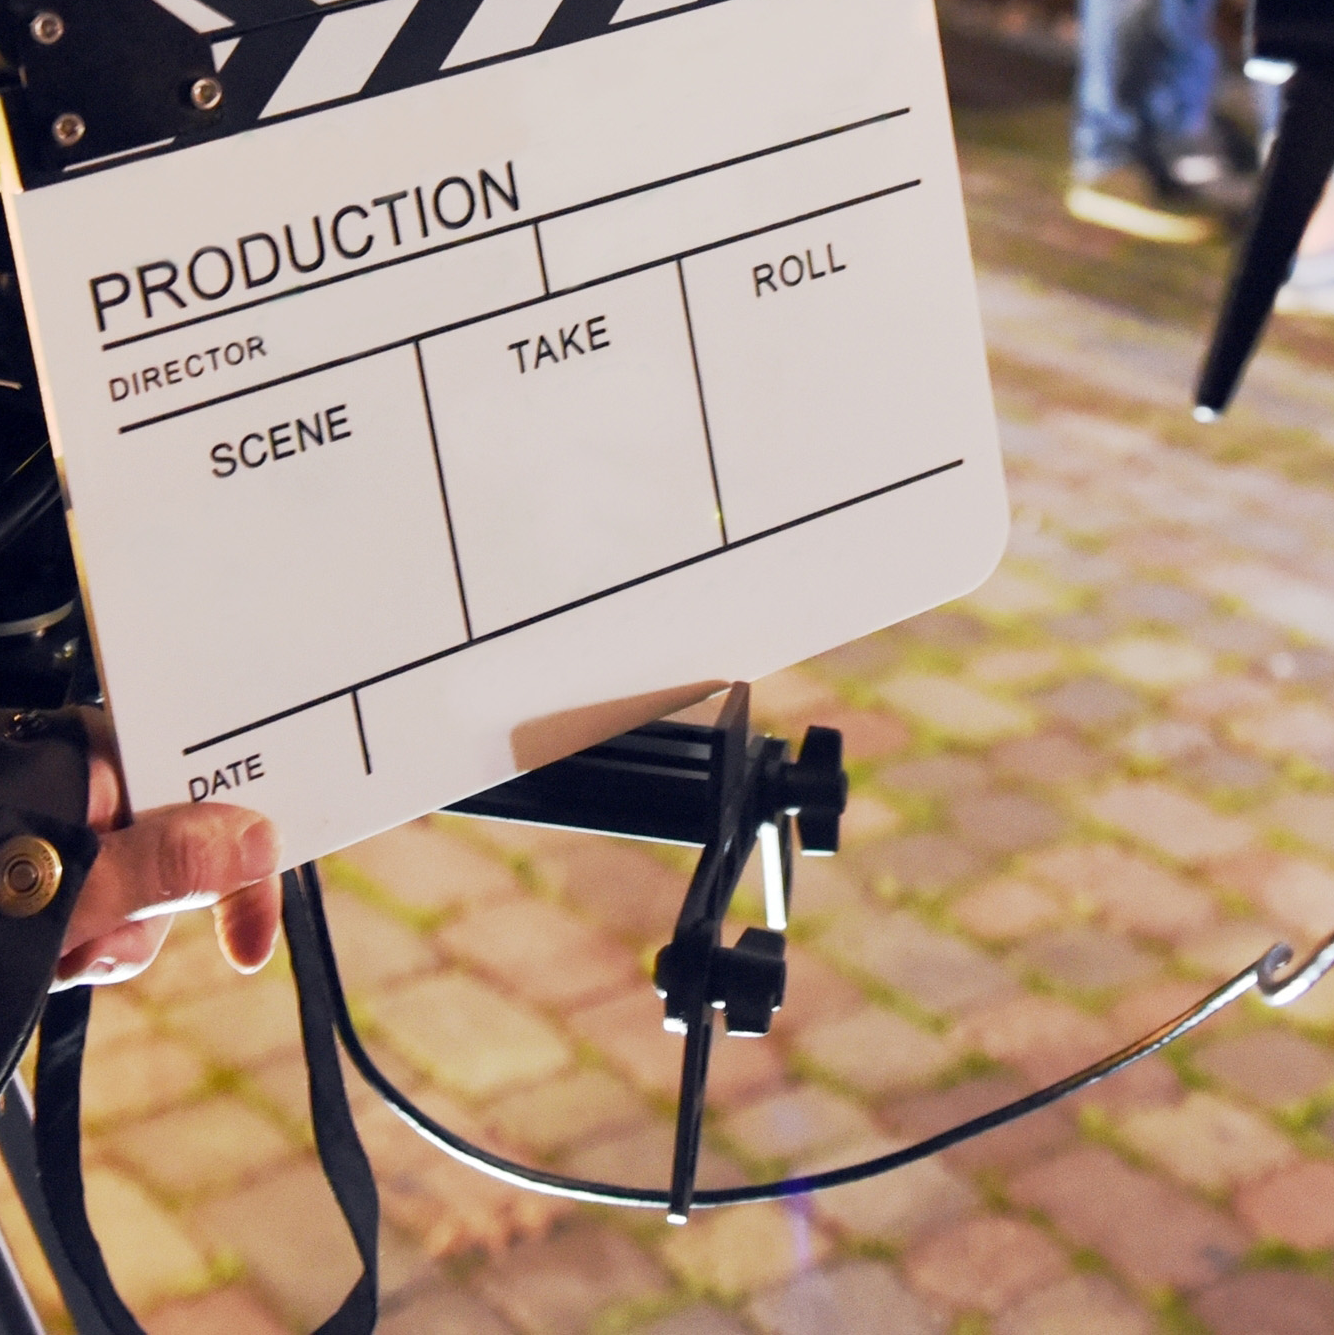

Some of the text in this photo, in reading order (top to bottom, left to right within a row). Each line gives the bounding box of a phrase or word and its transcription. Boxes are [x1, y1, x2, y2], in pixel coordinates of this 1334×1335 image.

[89, 160, 520, 333] PRODUCTION
[752, 243, 848, 298] ROLL
[109, 336, 267, 402] DIRECTOR
[507, 315, 611, 374] TAKE
[210, 404, 352, 479] SCENE
[189, 753, 265, 803] DATE
